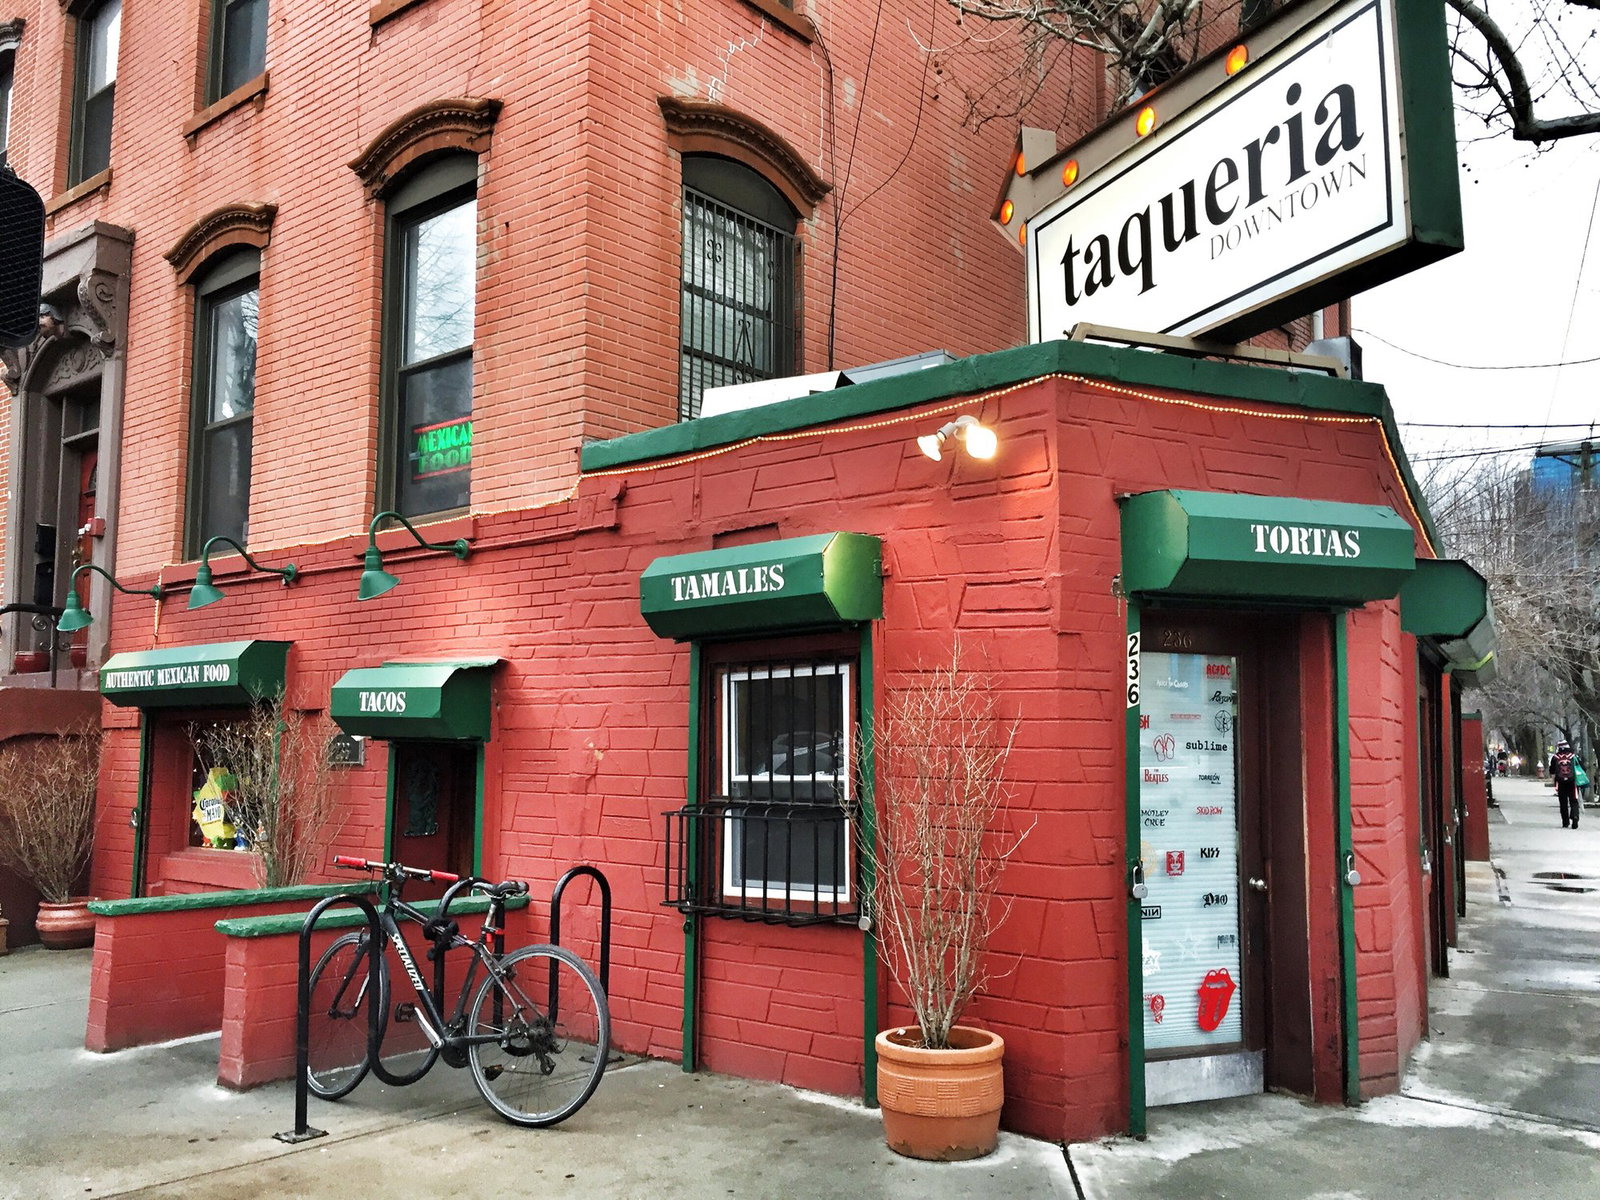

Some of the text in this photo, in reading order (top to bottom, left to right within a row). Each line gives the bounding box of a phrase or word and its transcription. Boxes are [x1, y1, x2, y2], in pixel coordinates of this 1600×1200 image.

[1060, 82, 1364, 307] taqueria
[1210, 153, 1367, 260] DOWNTOWN
[419, 445, 473, 473] FOOD
[1250, 524, 1361, 558] TORTAS
[671, 563, 785, 601] TAMALES
[105, 664, 230, 688] AUTHENTIC MEXICAN FOOD
[1127, 634, 1139, 705] 236
[359, 691, 406, 712] TACOS
[1185, 740, 1228, 752] sublime
[1144, 769, 1169, 784] BEATLES
[1200, 847, 1220, 858] KISS
[392, 933, 424, 991] SPECIALIZED
